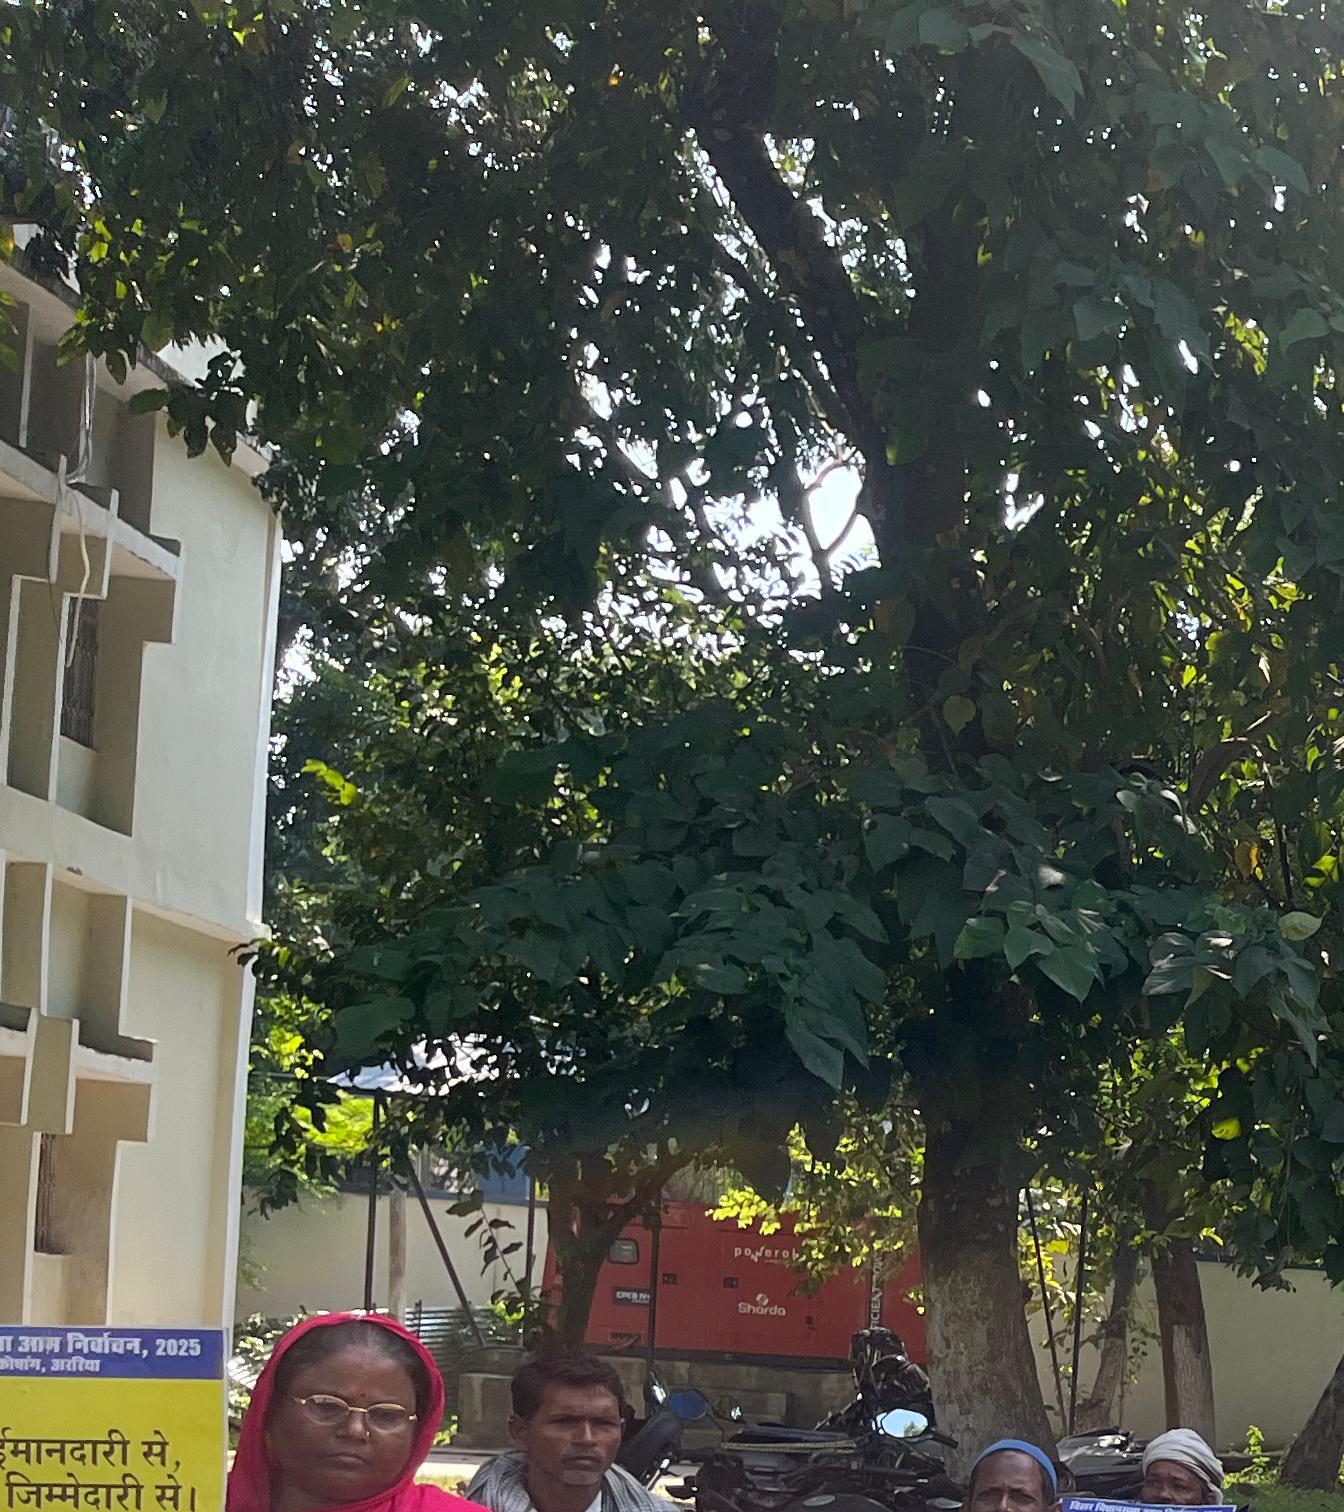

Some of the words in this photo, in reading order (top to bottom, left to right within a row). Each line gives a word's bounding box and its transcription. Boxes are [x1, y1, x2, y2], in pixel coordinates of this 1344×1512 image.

[738, 1301, 787, 1317] Sharda
[66, 1331, 149, 1359] निर्वाचन,
[154, 1337, 202, 1357] 2025
[51, 1356, 102, 1373] अररिया
[140, 1429, 182, 1474] से,
[5, 1470, 145, 1511] जिम्मेदारी
